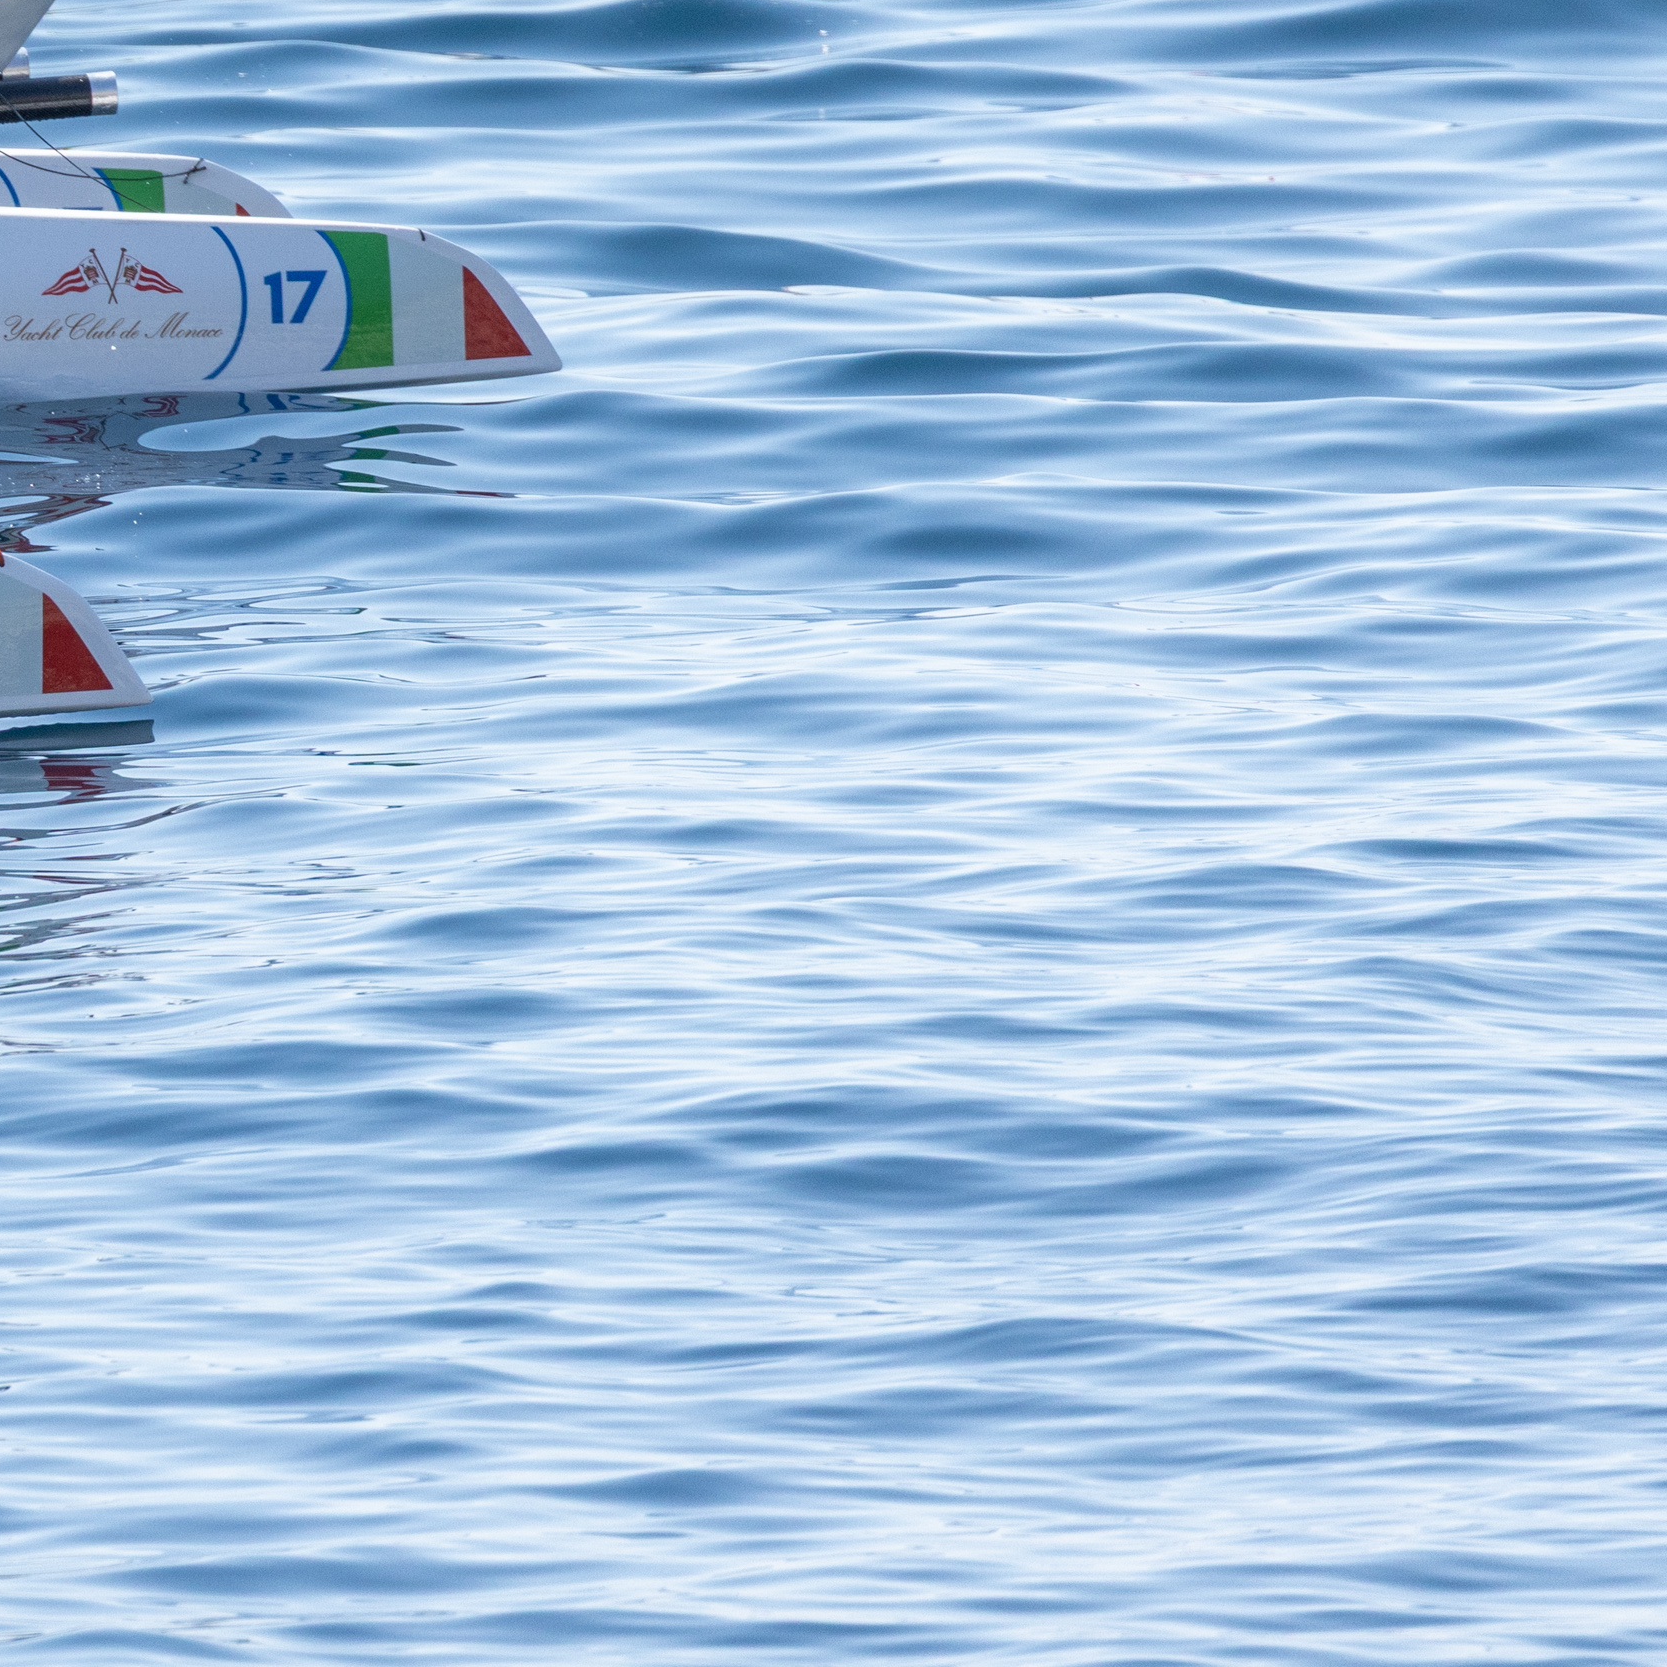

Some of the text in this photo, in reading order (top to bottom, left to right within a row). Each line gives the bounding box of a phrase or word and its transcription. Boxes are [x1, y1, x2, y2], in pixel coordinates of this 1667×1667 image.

[264, 269, 328, 324] 17
[3, 311, 224, 342] Yacht Club de Monaco
